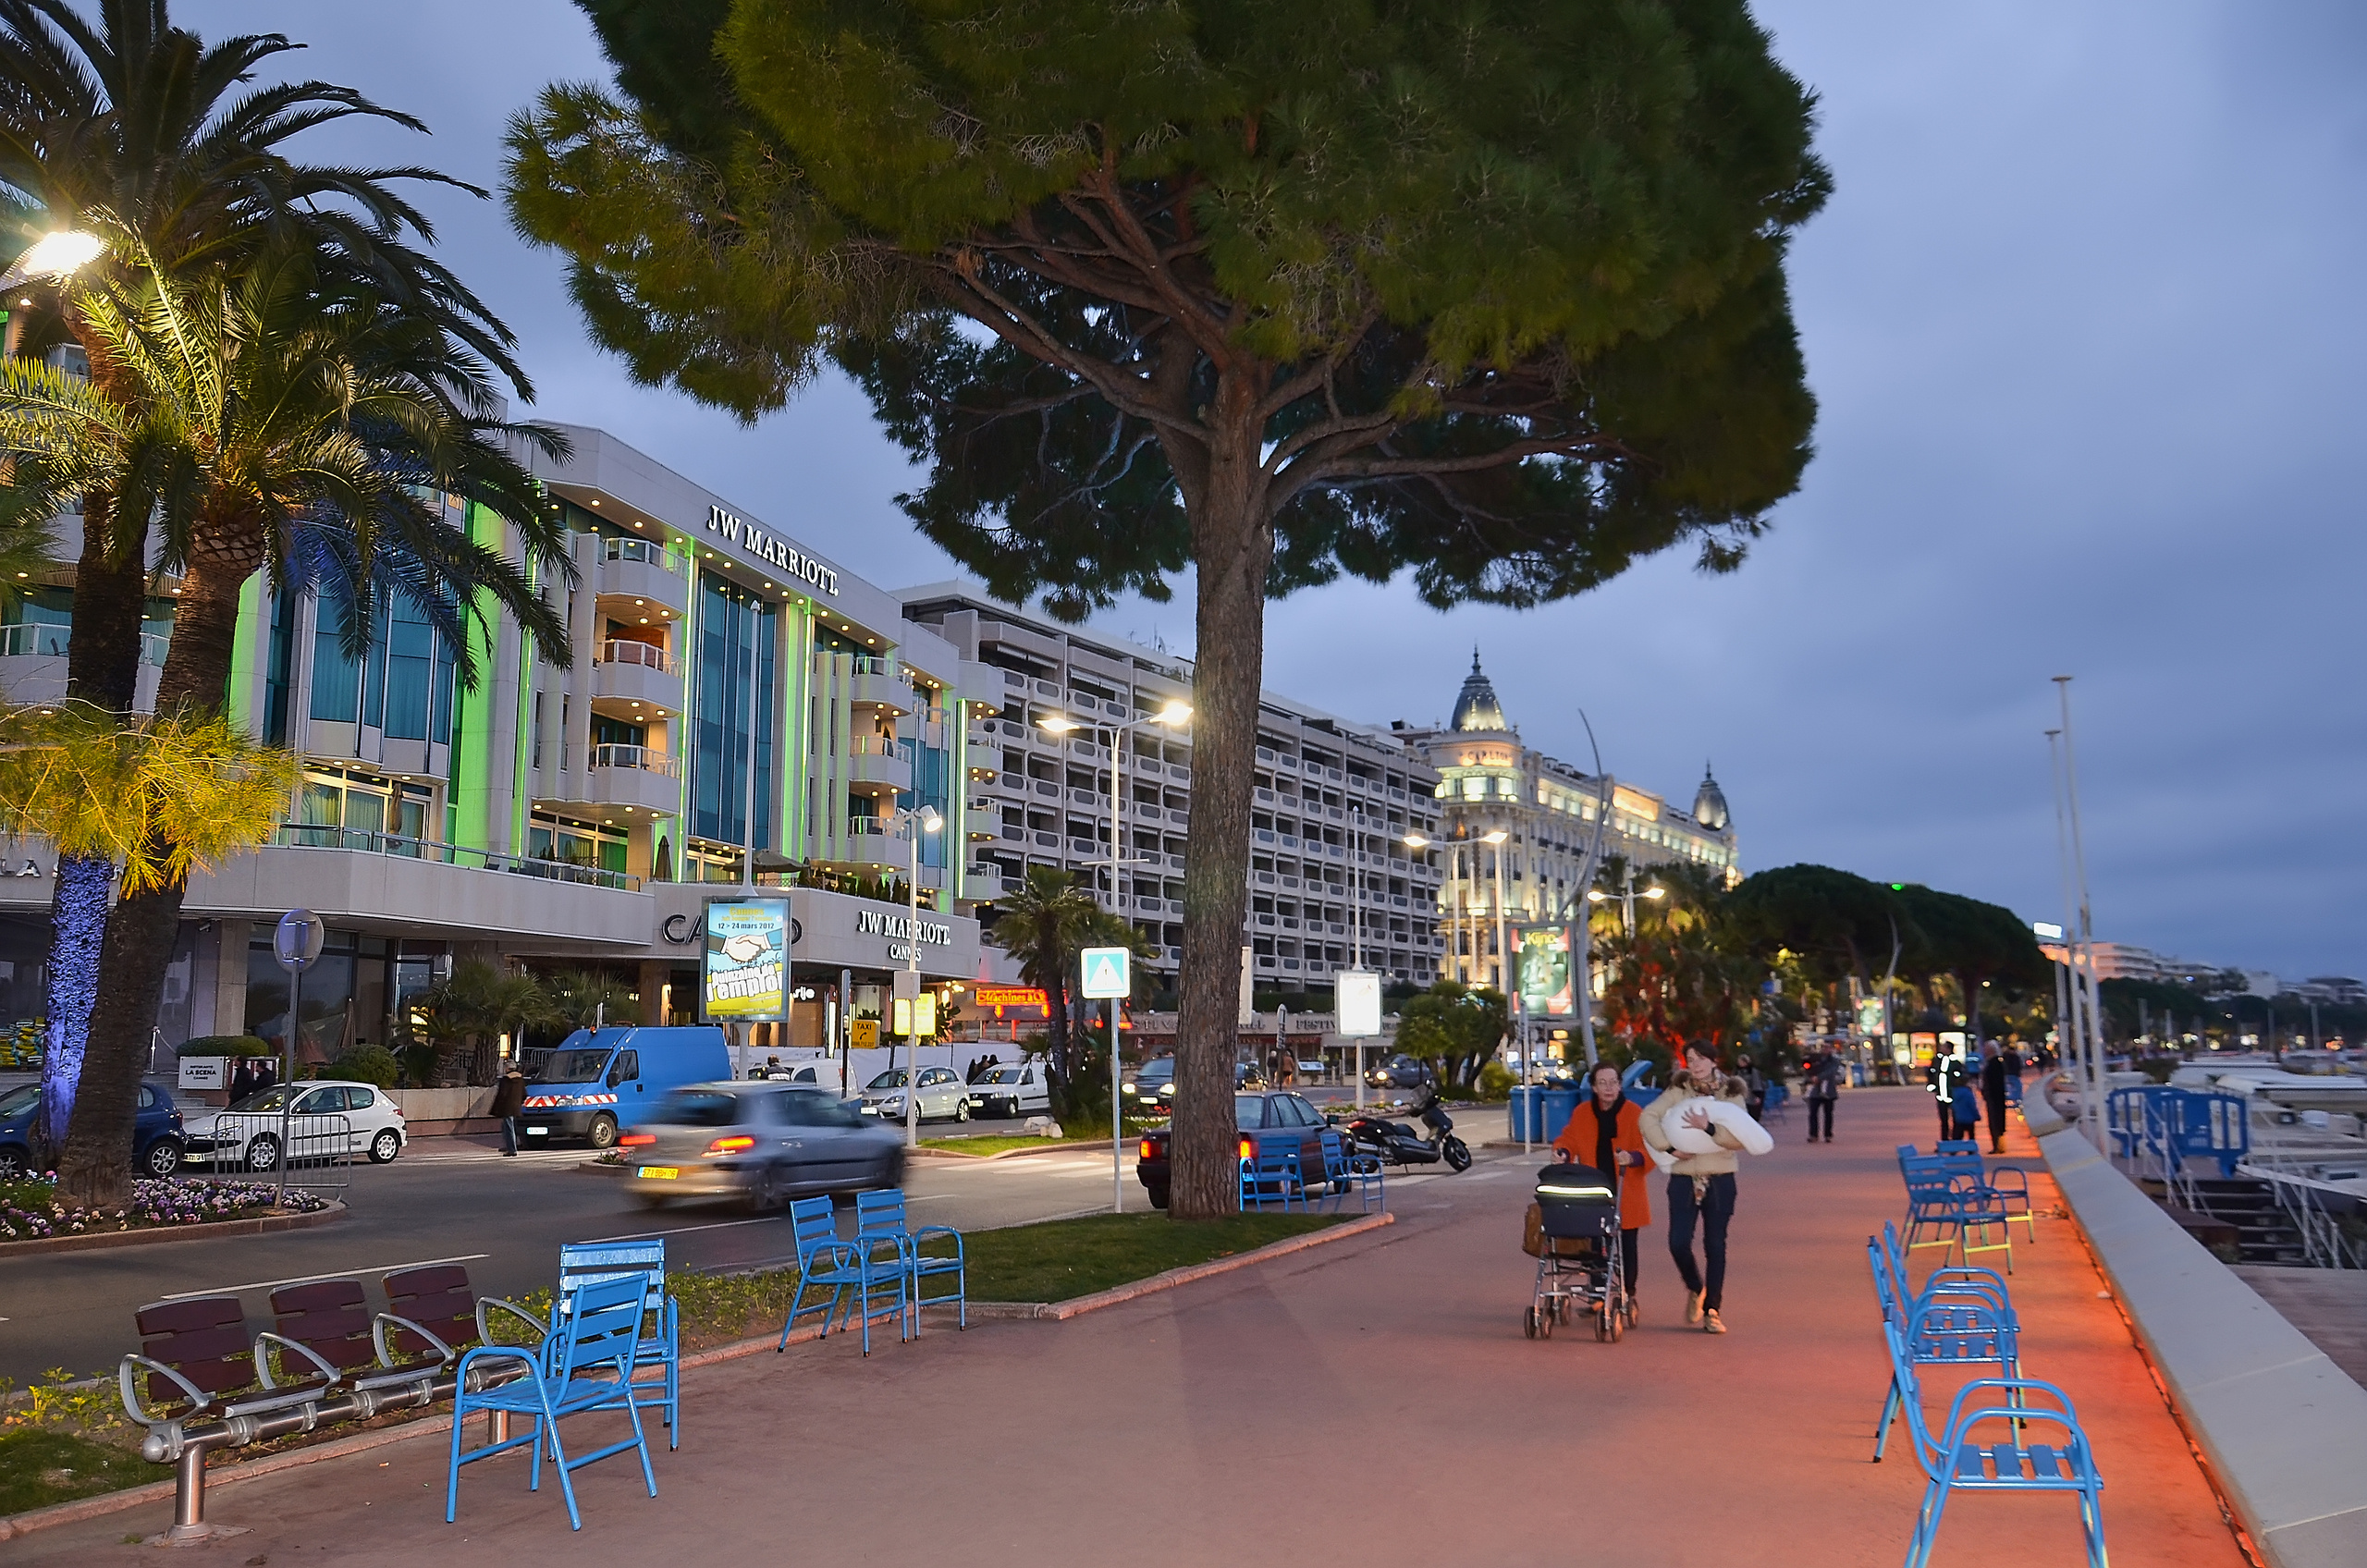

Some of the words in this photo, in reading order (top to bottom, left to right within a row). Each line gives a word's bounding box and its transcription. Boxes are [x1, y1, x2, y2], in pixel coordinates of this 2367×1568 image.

[707, 504, 741, 542] JW
[744, 523, 839, 596] MARRIOTT
[859, 911, 882, 934] JW
[889, 943, 922, 962] CANNS
